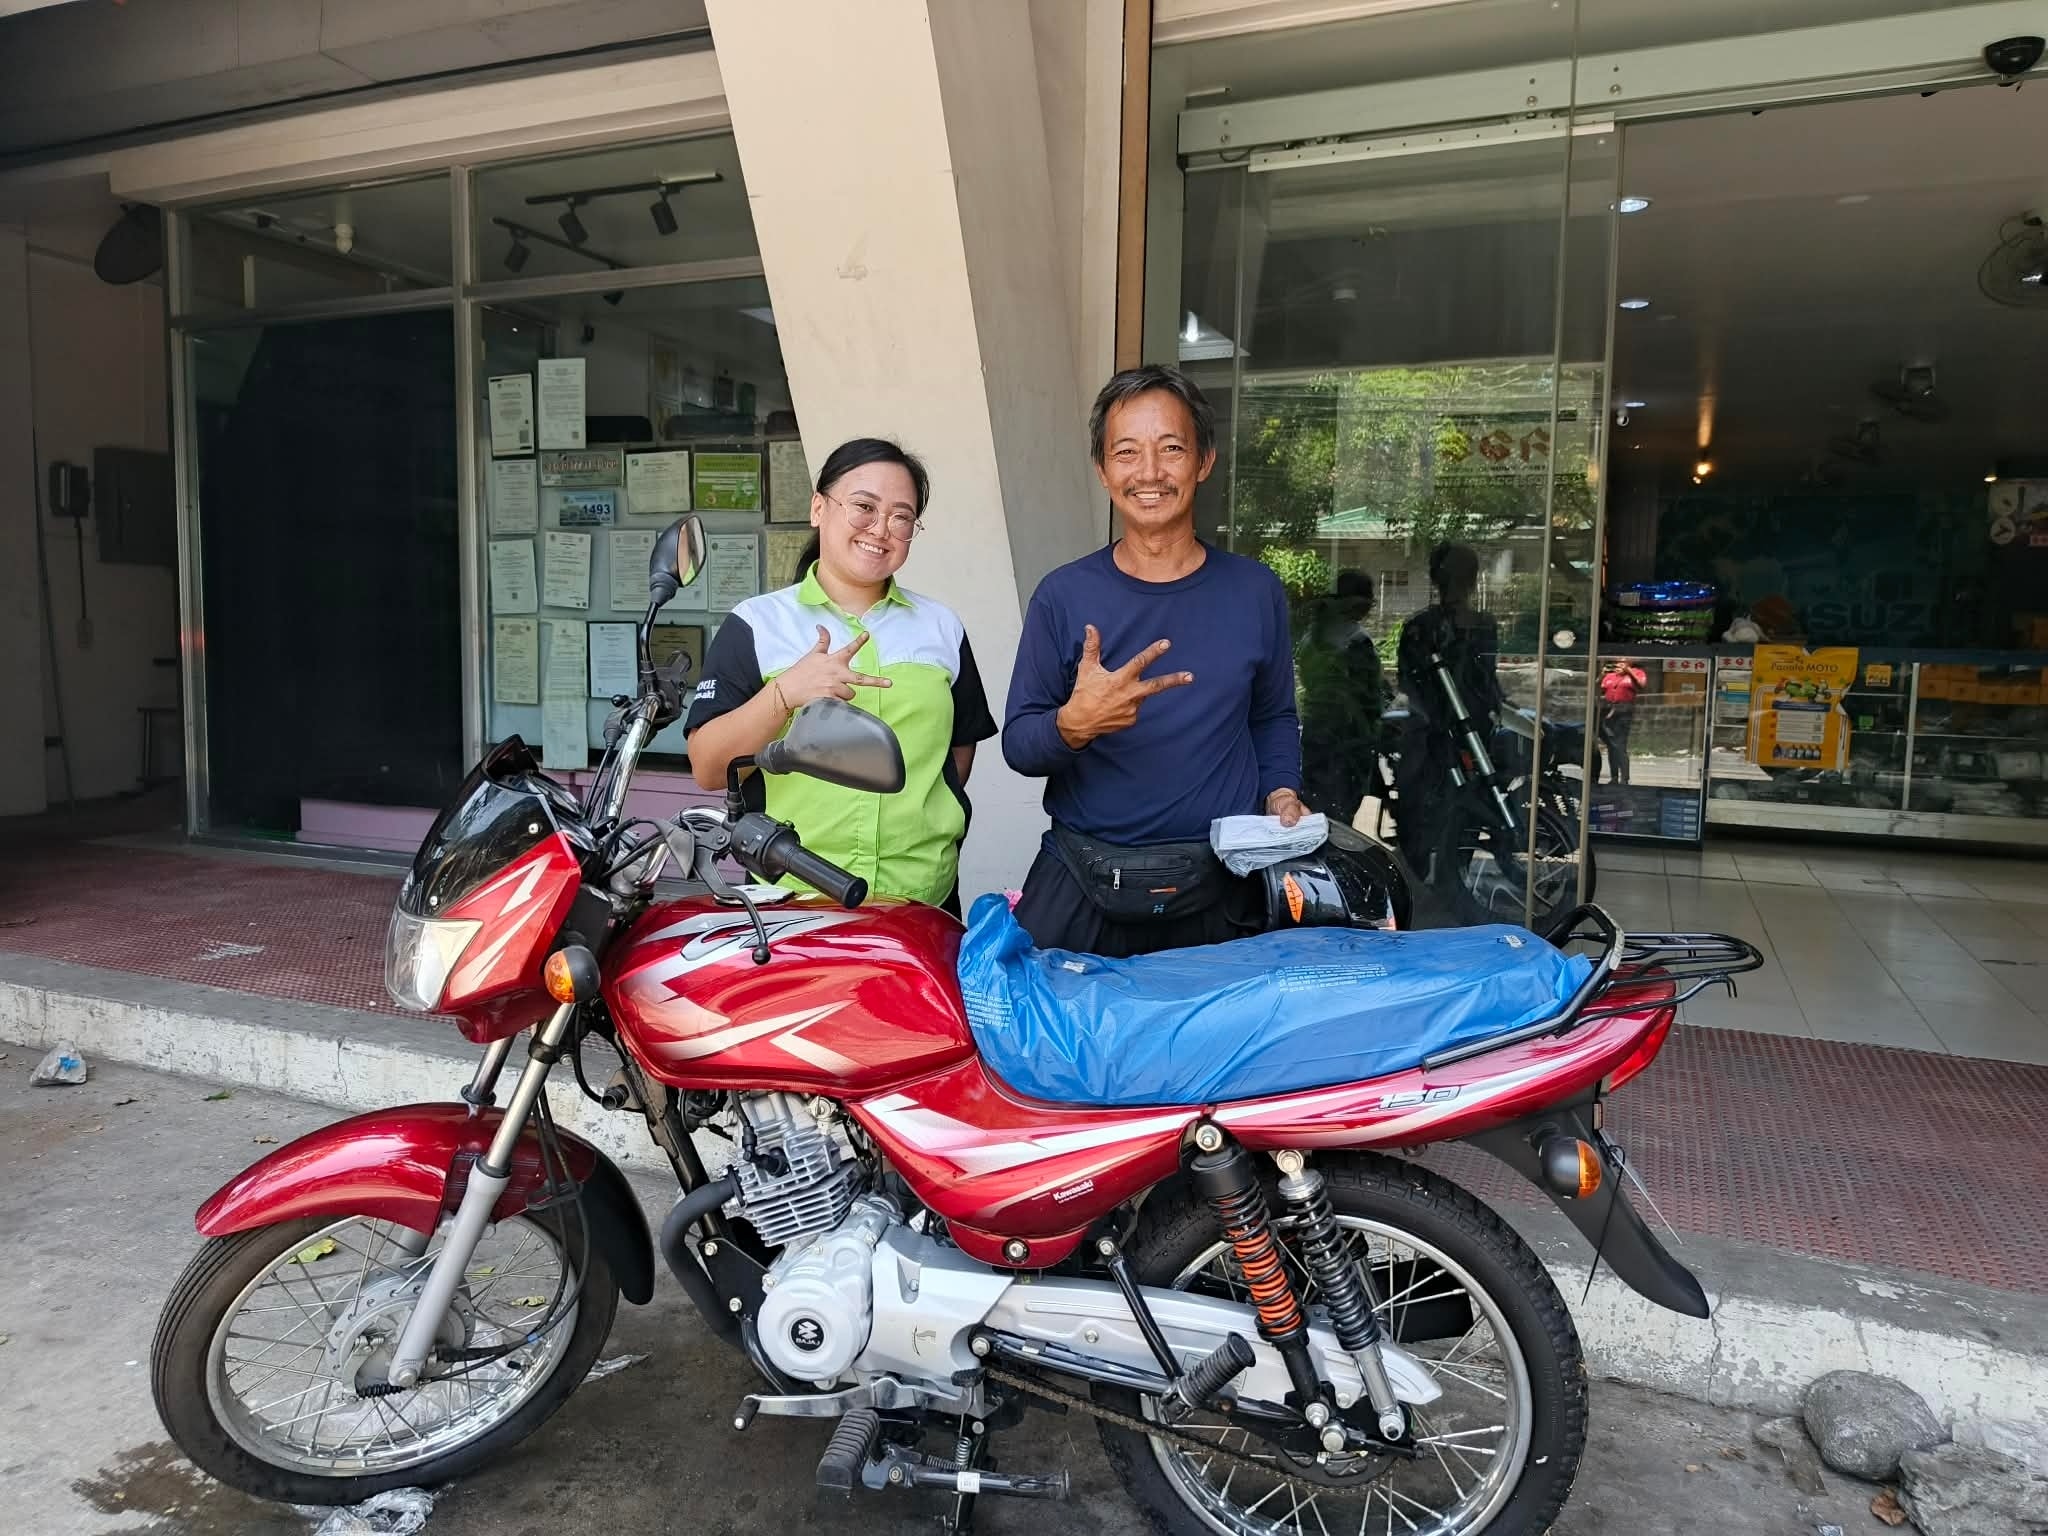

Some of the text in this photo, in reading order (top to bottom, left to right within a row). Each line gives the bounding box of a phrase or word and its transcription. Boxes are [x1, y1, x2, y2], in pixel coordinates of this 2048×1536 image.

[1489, 475, 1568, 487] ACCESSOES
[583, 503, 610, 515] 1493
[1810, 601, 1930, 633] SUZ
[1806, 663, 1839, 673] MOTO
[1378, 1085, 1462, 1110] 150
[1052, 1179, 1094, 1201] Kawasaki
[795, 1337, 821, 1347] BAJAJ
